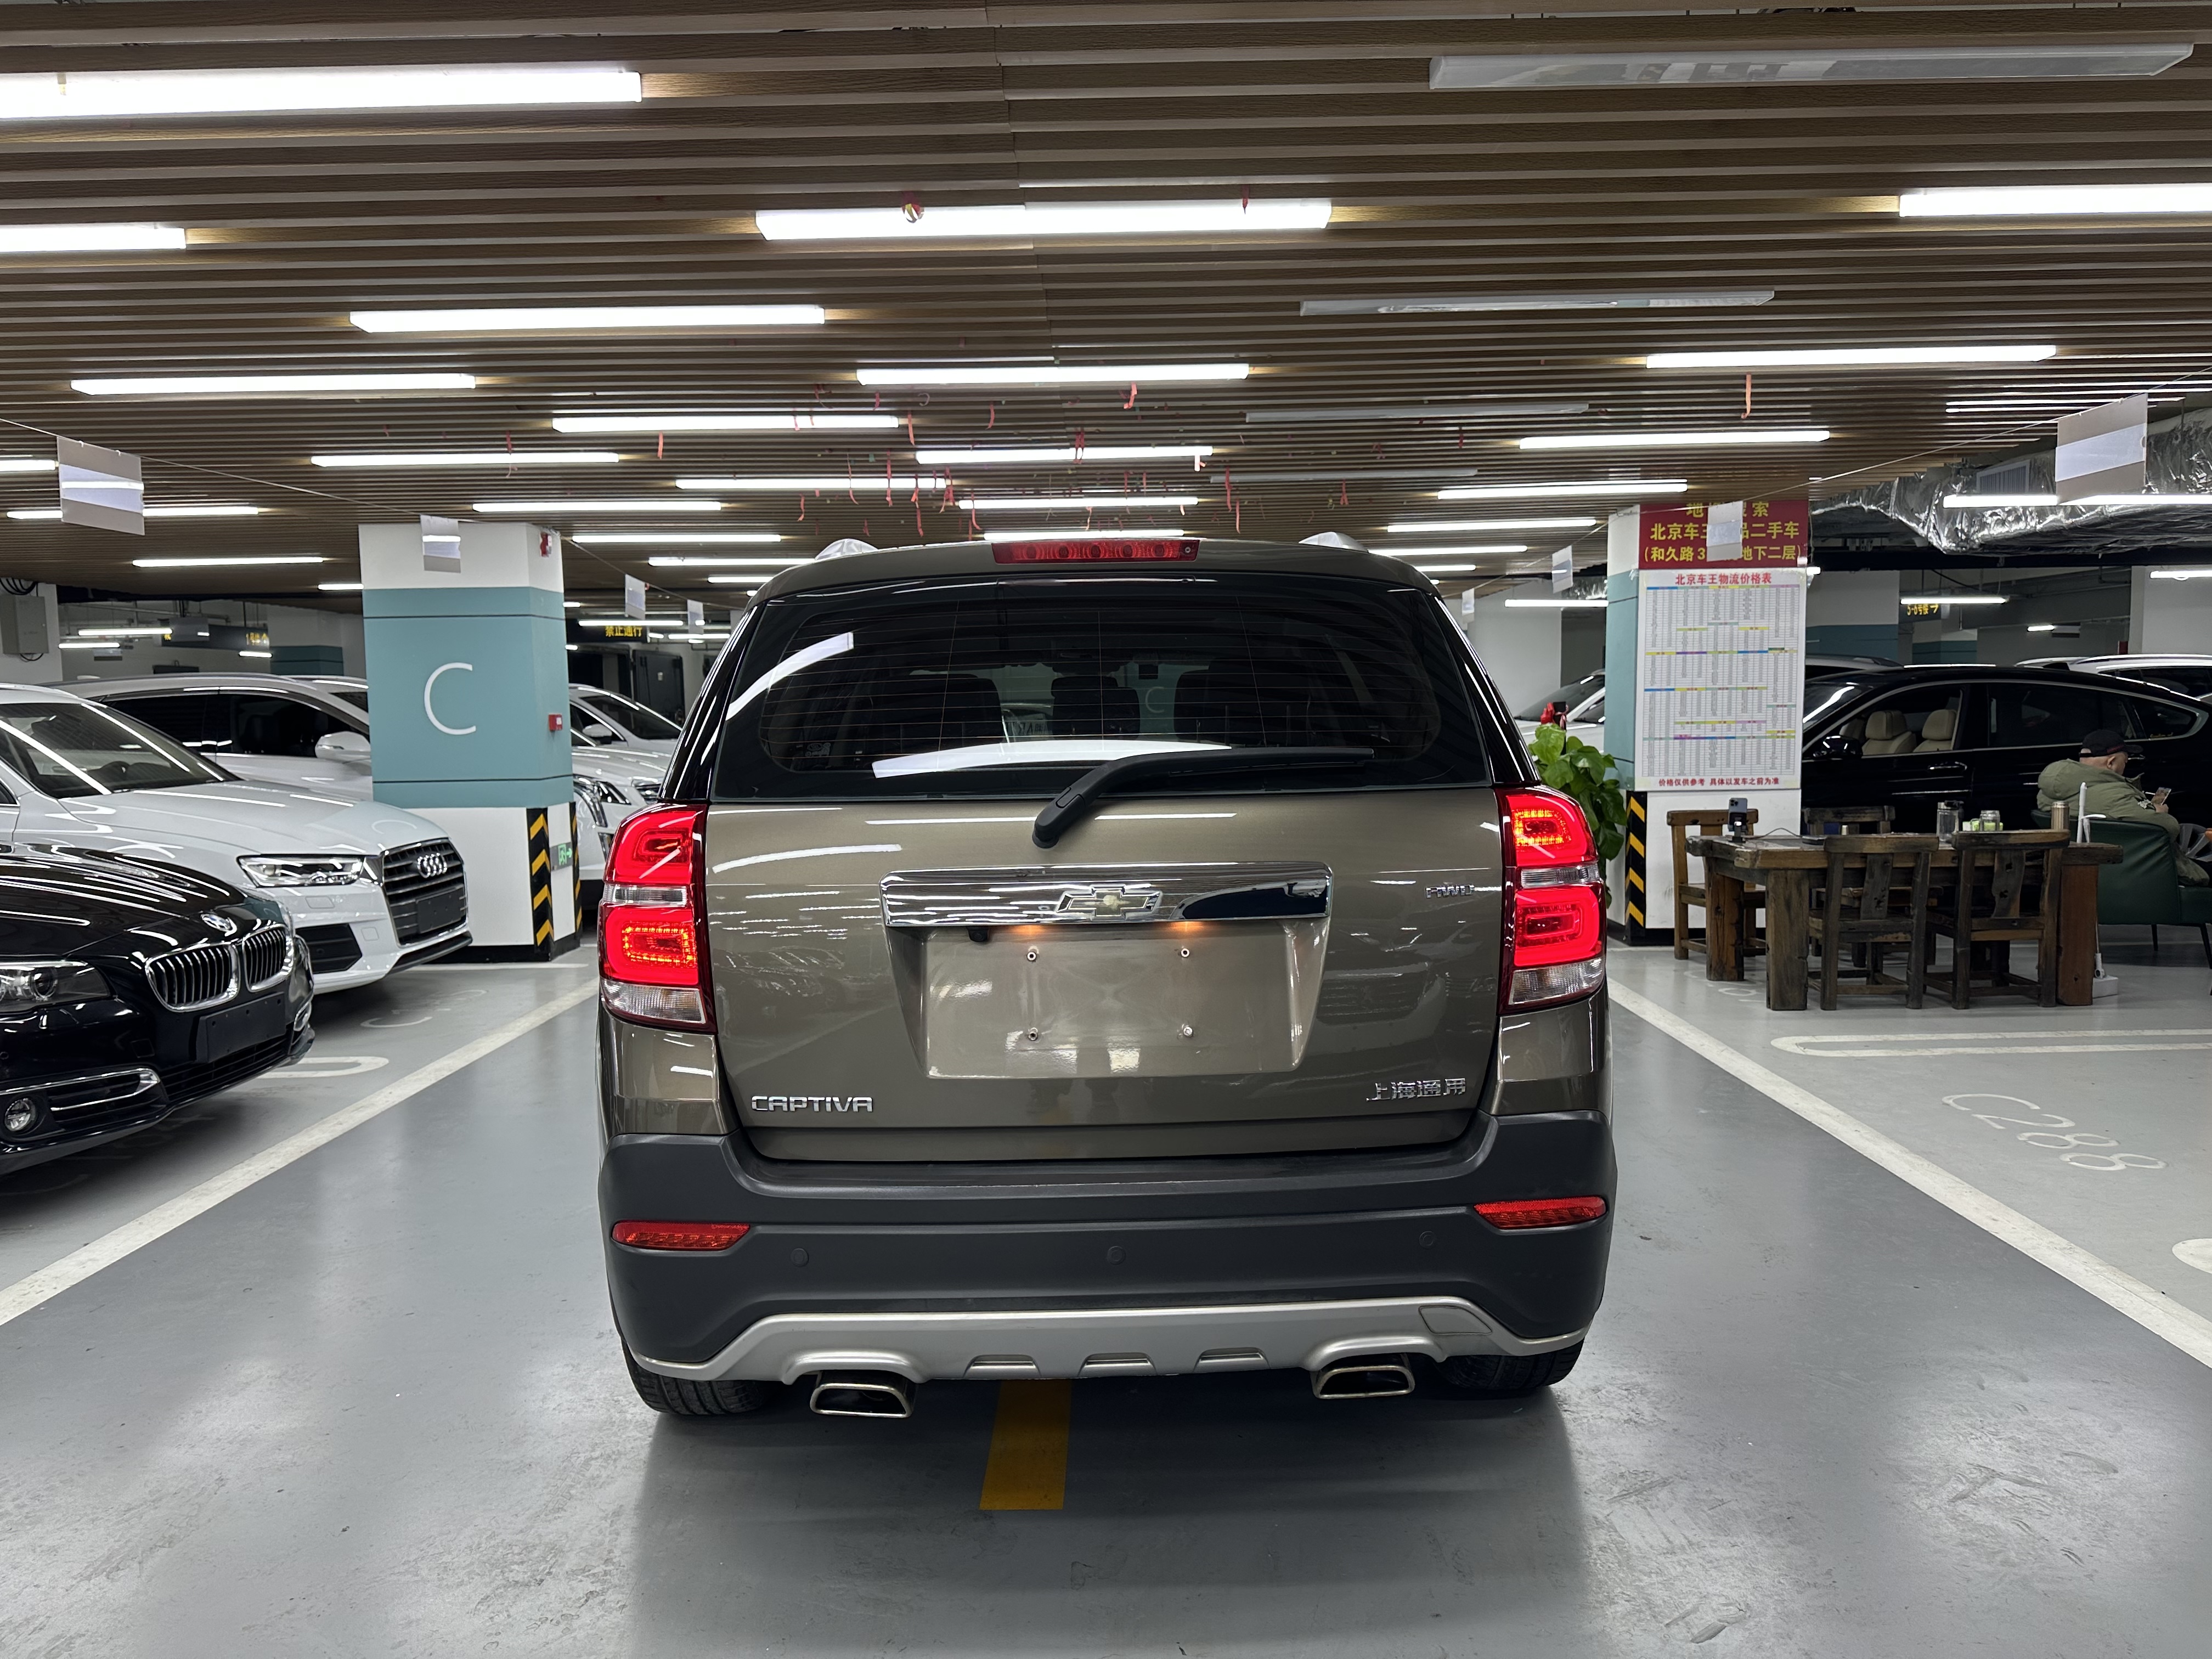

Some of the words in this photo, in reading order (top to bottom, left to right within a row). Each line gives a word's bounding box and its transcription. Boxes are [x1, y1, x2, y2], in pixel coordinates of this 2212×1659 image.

[1675, 573, 1772, 585] 北京车王物流价格表
[424, 662, 476, 735] C
[1659, 778, 1705, 787] 价格仅供参考
[1709, 777, 1780, 786] 具体以发车之前为准
[1366, 1077, 1466, 1102] 上海通用
[751, 1096, 873, 1113] CAPTIVA
